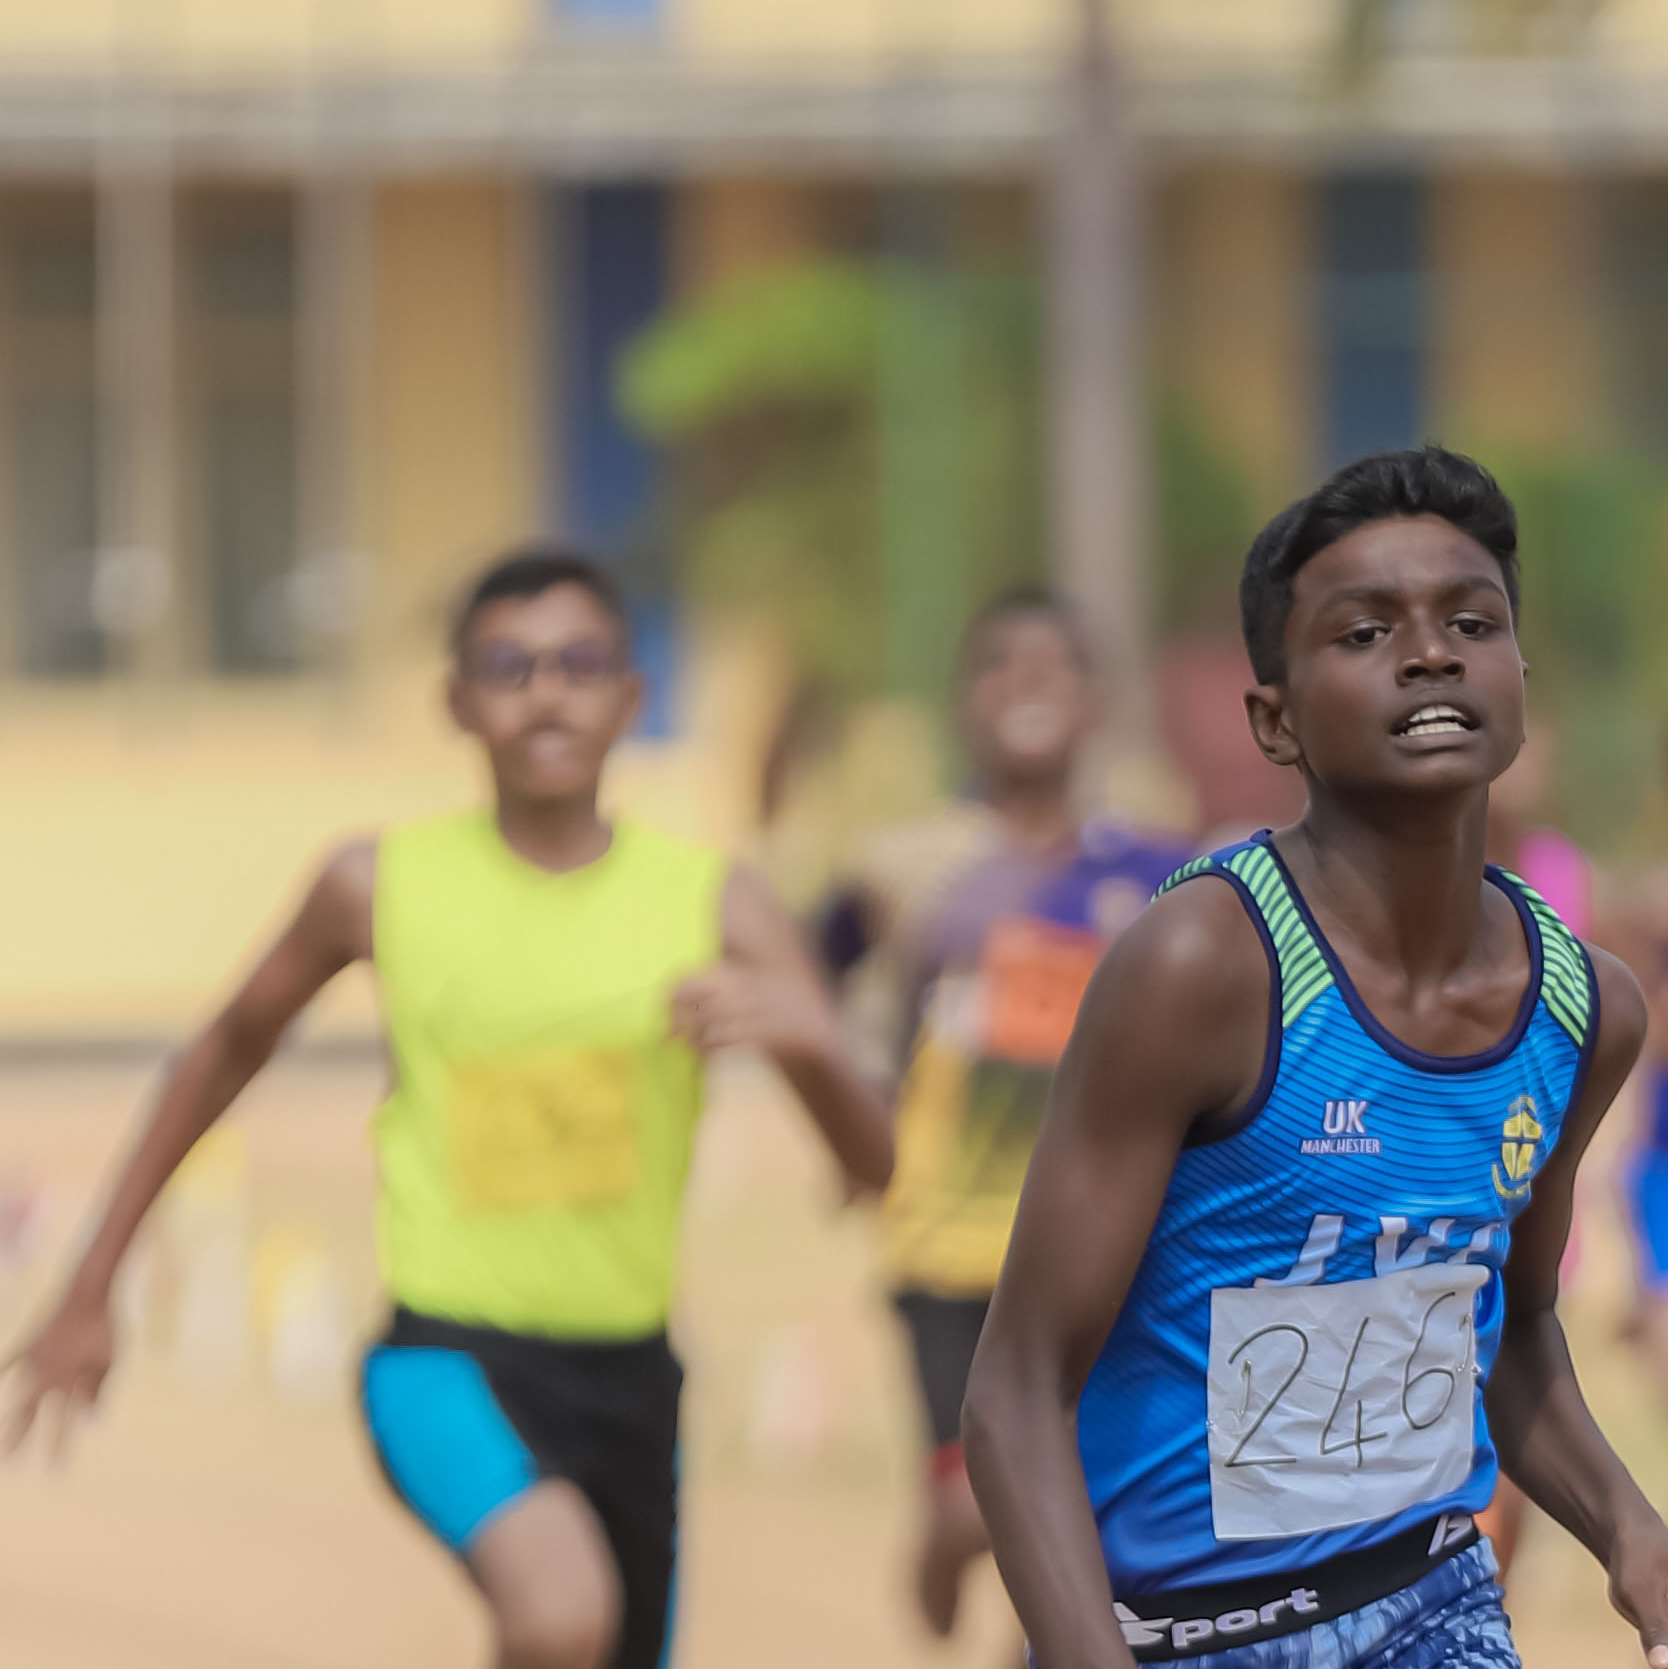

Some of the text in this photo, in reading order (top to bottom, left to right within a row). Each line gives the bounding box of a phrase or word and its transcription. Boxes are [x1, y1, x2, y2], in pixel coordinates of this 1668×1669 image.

[1323, 1100, 1368, 1134] UK
[1299, 1137, 1381, 1155] MANCHESTER
[1224, 1291, 1456, 1468] 246
